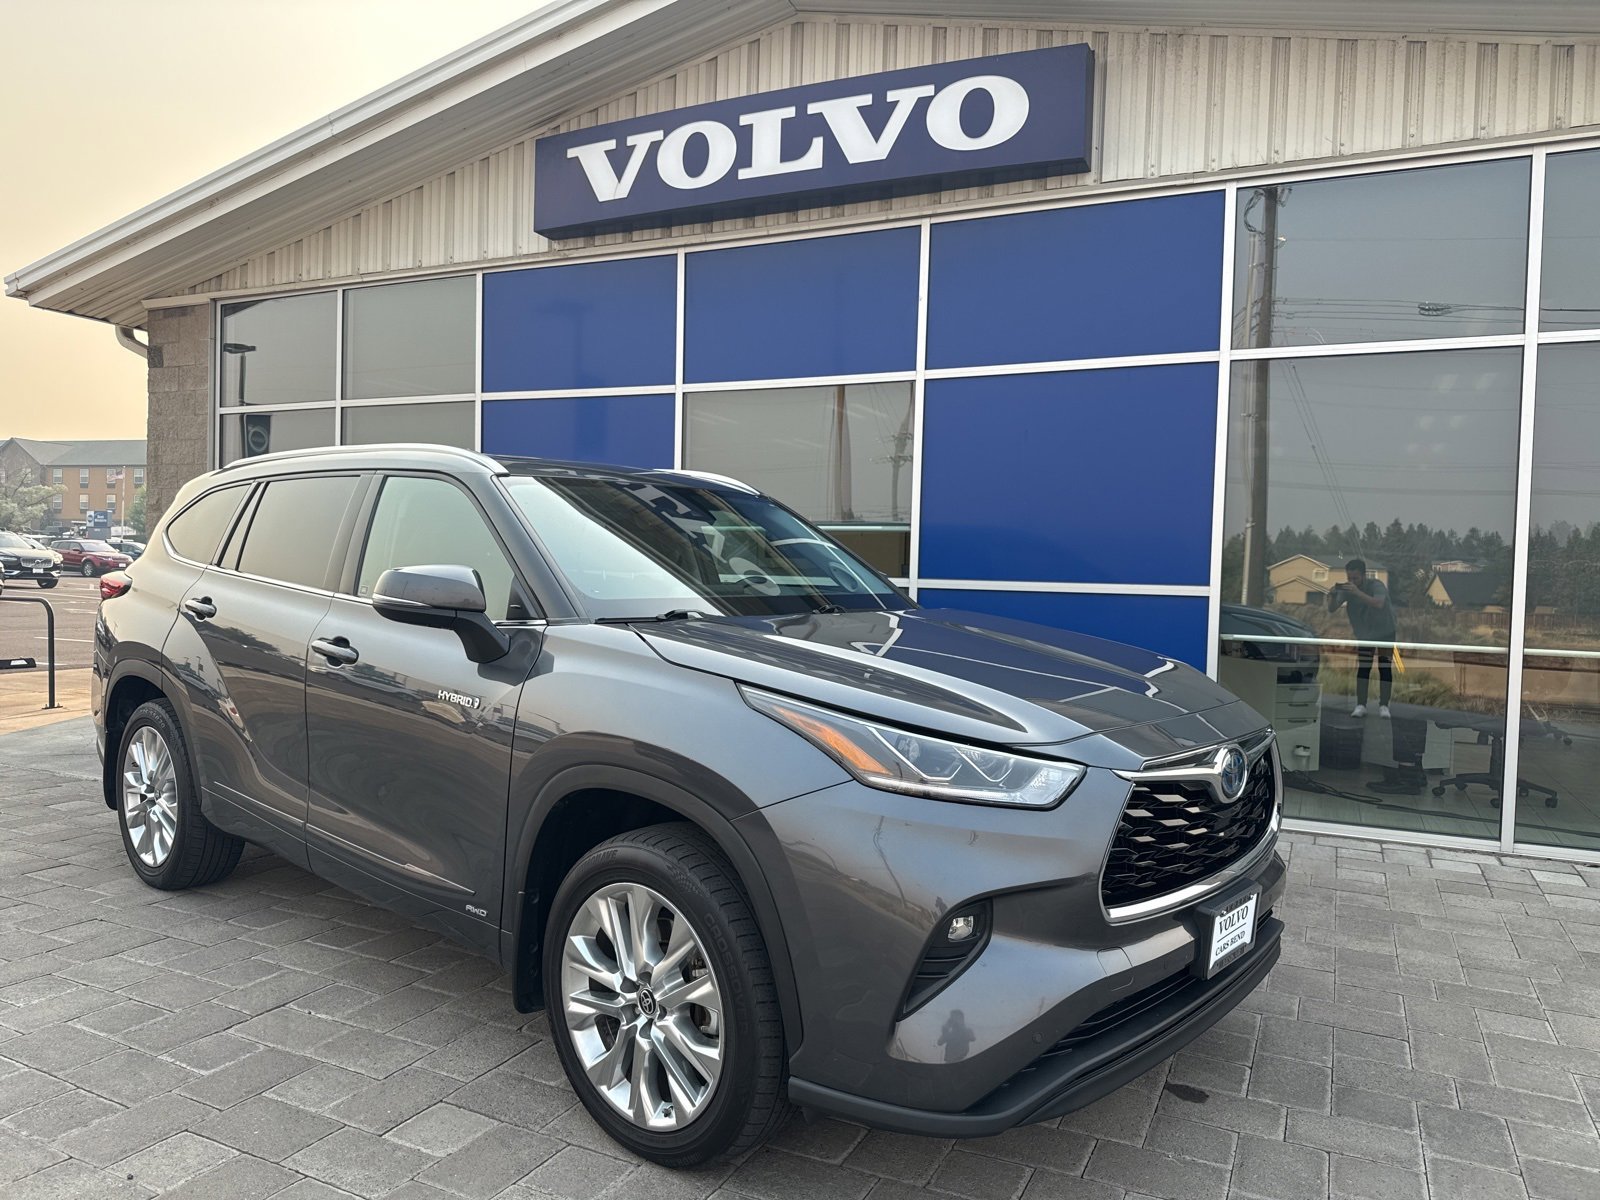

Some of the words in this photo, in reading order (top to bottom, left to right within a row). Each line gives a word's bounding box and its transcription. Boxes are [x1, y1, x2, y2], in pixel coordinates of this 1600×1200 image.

[567, 74, 1030, 203] VOLVO
[437, 689, 473, 708] HYBRID
[1219, 905, 1249, 935] VOLVO
[1215, 940, 1230, 957] CARS
[1229, 930, 1246, 947] BEND
